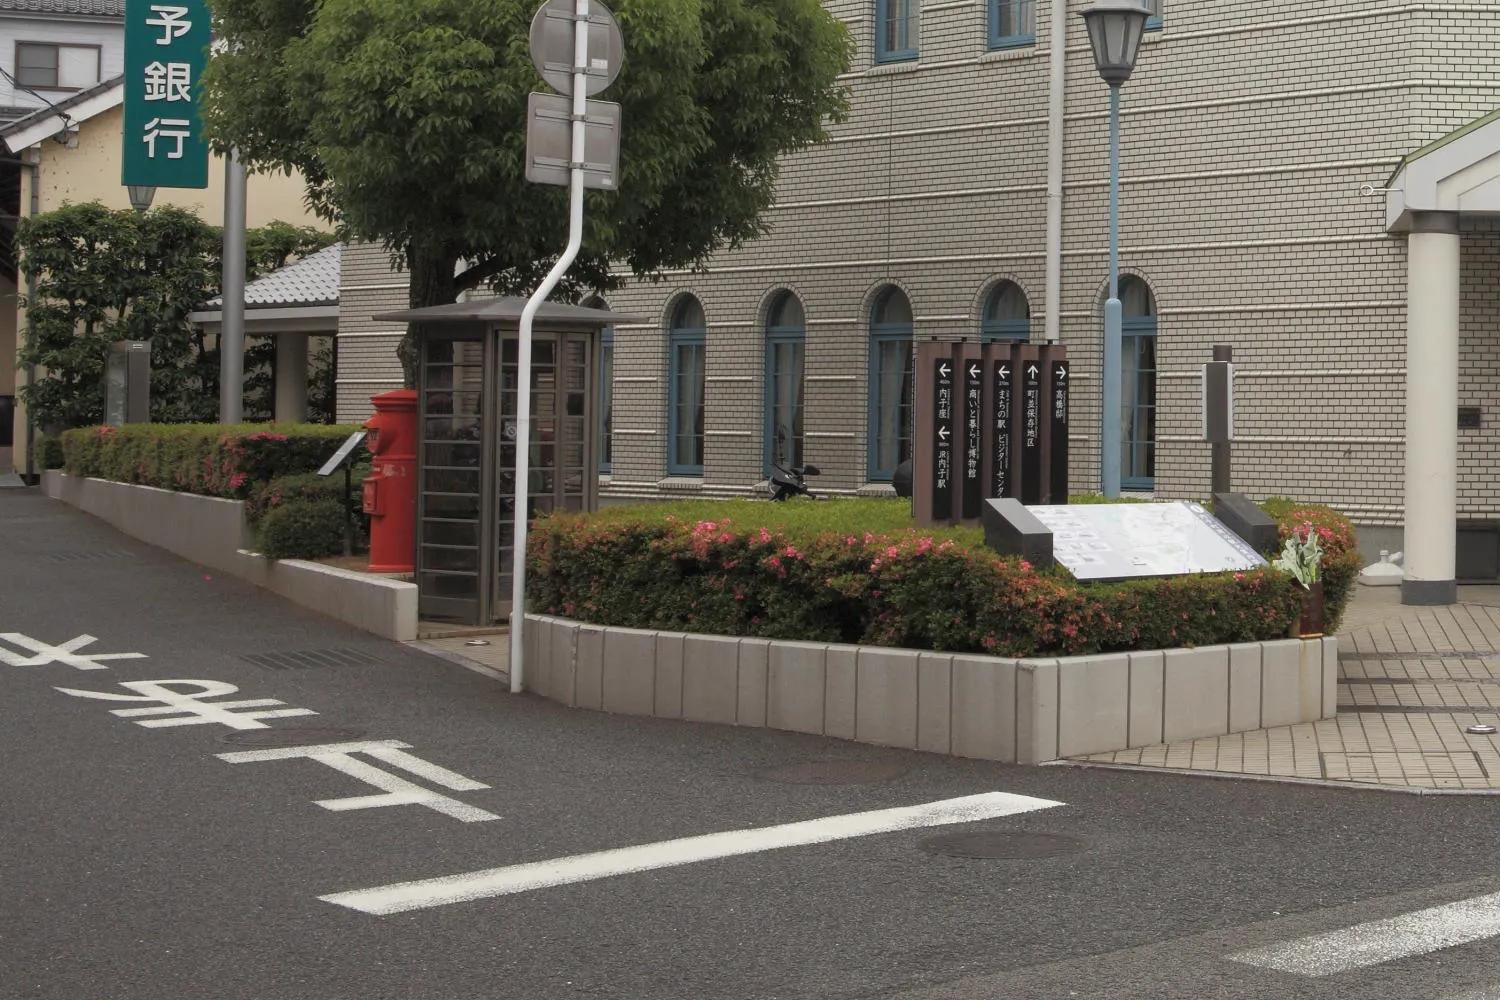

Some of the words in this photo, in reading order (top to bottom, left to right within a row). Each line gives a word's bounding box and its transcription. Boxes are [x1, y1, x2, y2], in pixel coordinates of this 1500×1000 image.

[939, 389, 947, 419] 内子座
[997, 390, 1006, 429] まちの駅
[1027, 389, 1035, 447] 町並保存地区
[937, 451, 947, 489] JR内子駅
[996, 434, 1005, 498] ビジターセンタ
